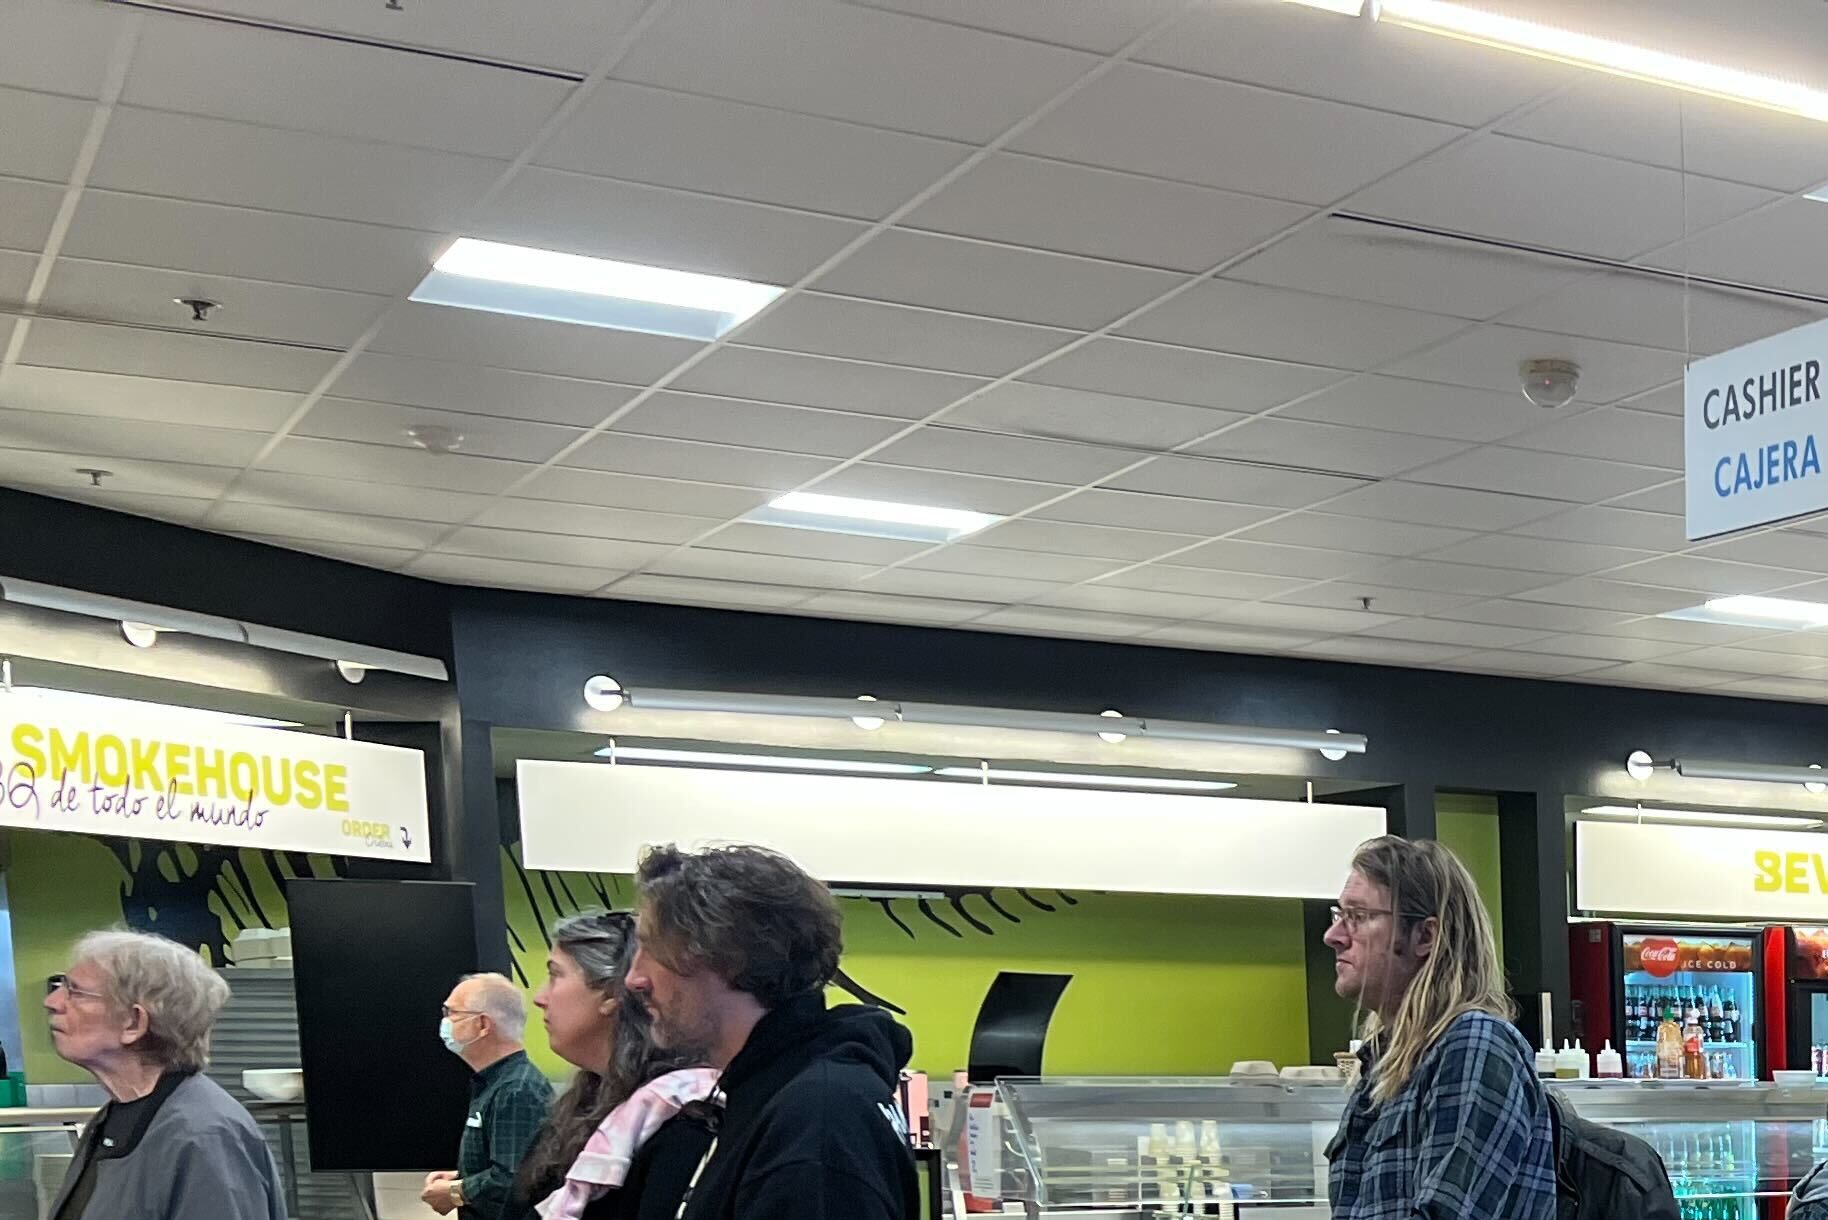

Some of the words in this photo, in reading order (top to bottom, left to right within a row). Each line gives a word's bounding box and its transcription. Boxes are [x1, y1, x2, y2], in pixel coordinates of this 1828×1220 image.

[1703, 359, 1821, 430] CASHIER
[1714, 434, 1821, 497] CAJERA
[11, 724, 350, 812] SMOKEHOUSE
[50, 767, 82, 813] de
[89, 774, 150, 817] todo
[155, 777, 182, 820] el
[190, 789, 269, 831] mundo
[1706, 960, 1737, 969] COLD
